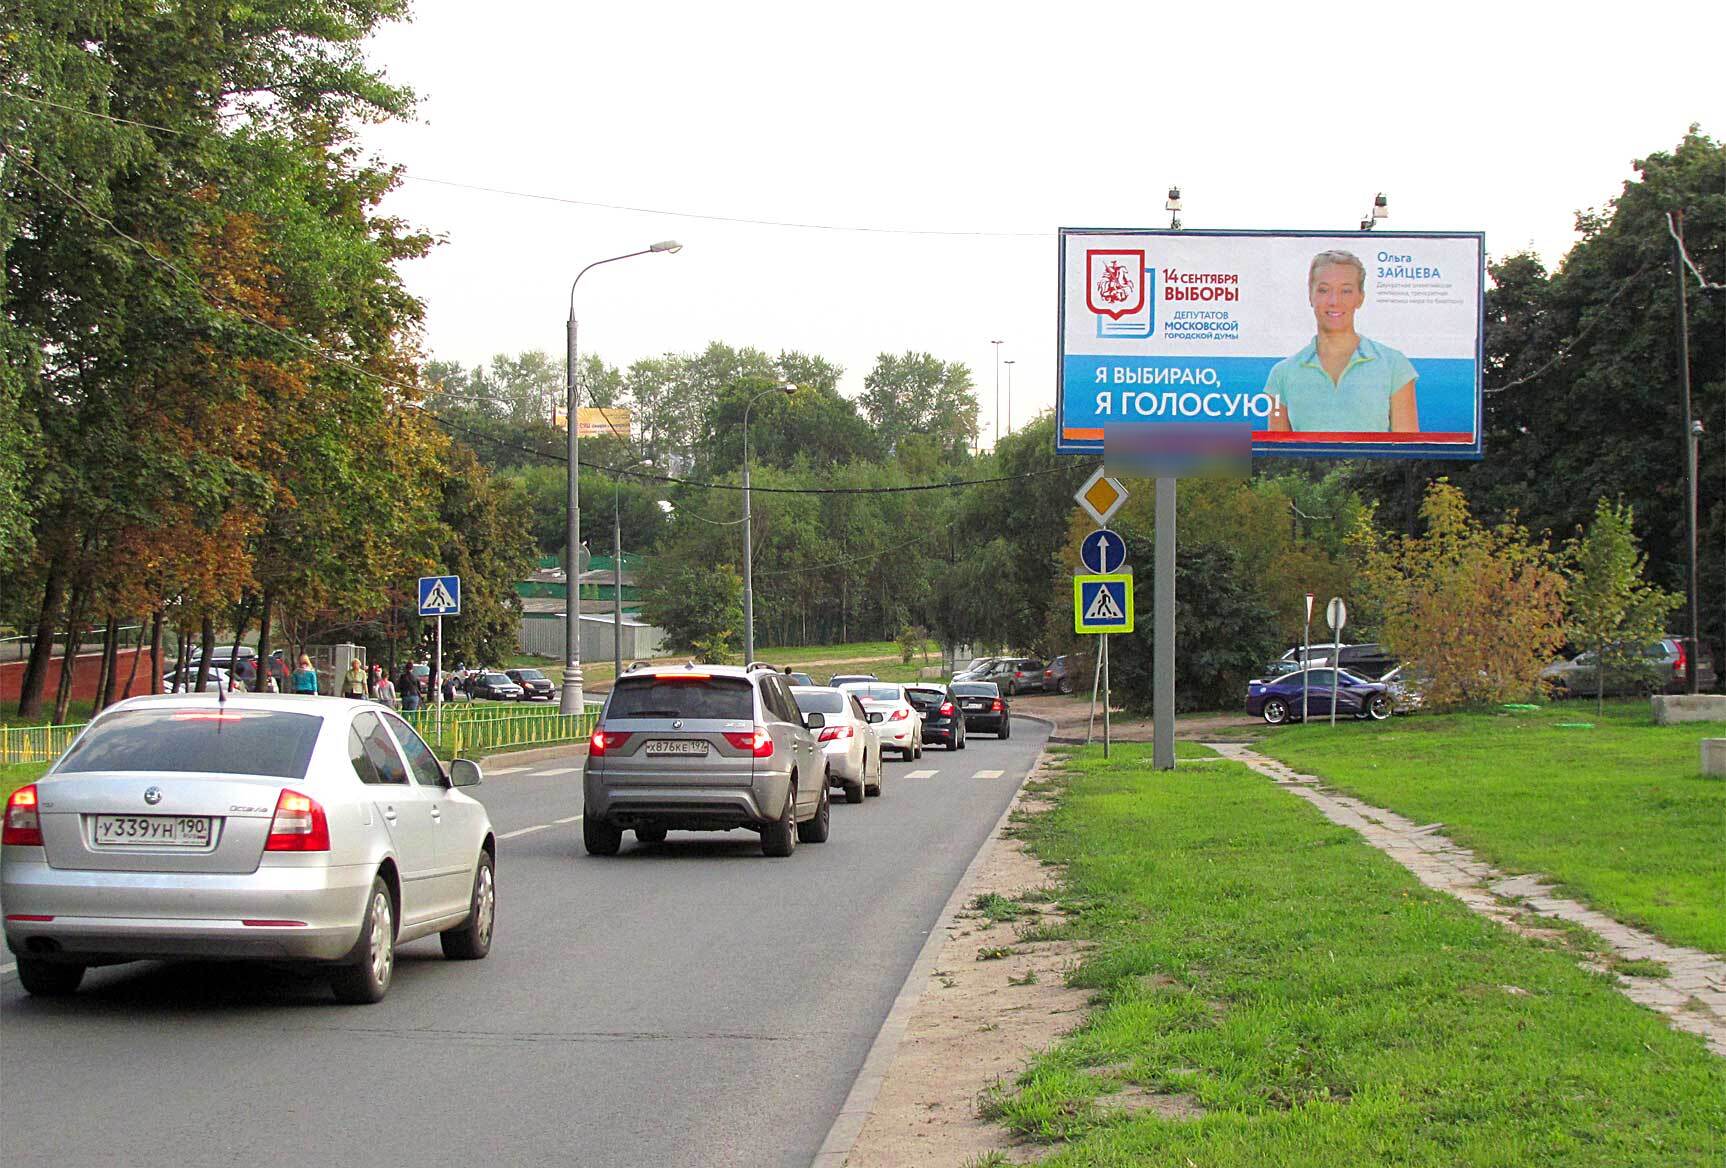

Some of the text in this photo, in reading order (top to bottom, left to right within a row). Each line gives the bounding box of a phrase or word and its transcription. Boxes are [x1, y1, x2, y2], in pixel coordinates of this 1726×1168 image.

[1377, 251, 1412, 263] Ольга
[1162, 268, 1238, 285] 14 СЕНТЯБРЯ
[1377, 265, 1441, 280] ЗАЙЦЕВА
[1164, 286, 1239, 302] ВЫБОРЫ
[1173, 310, 1229, 320] ДЕПУТАТОВ
[1164, 320, 1239, 331] МОСКОВСКОЙ
[1164, 331, 1239, 340] ГОРОДСКОЙ ДУМЫ
[1095, 367, 1221, 388] Я ВЫБИРАЮ,
[1095, 391, 1280, 417] Я ГОЛОСУЮ!
[177, 818, 205, 833] 190
